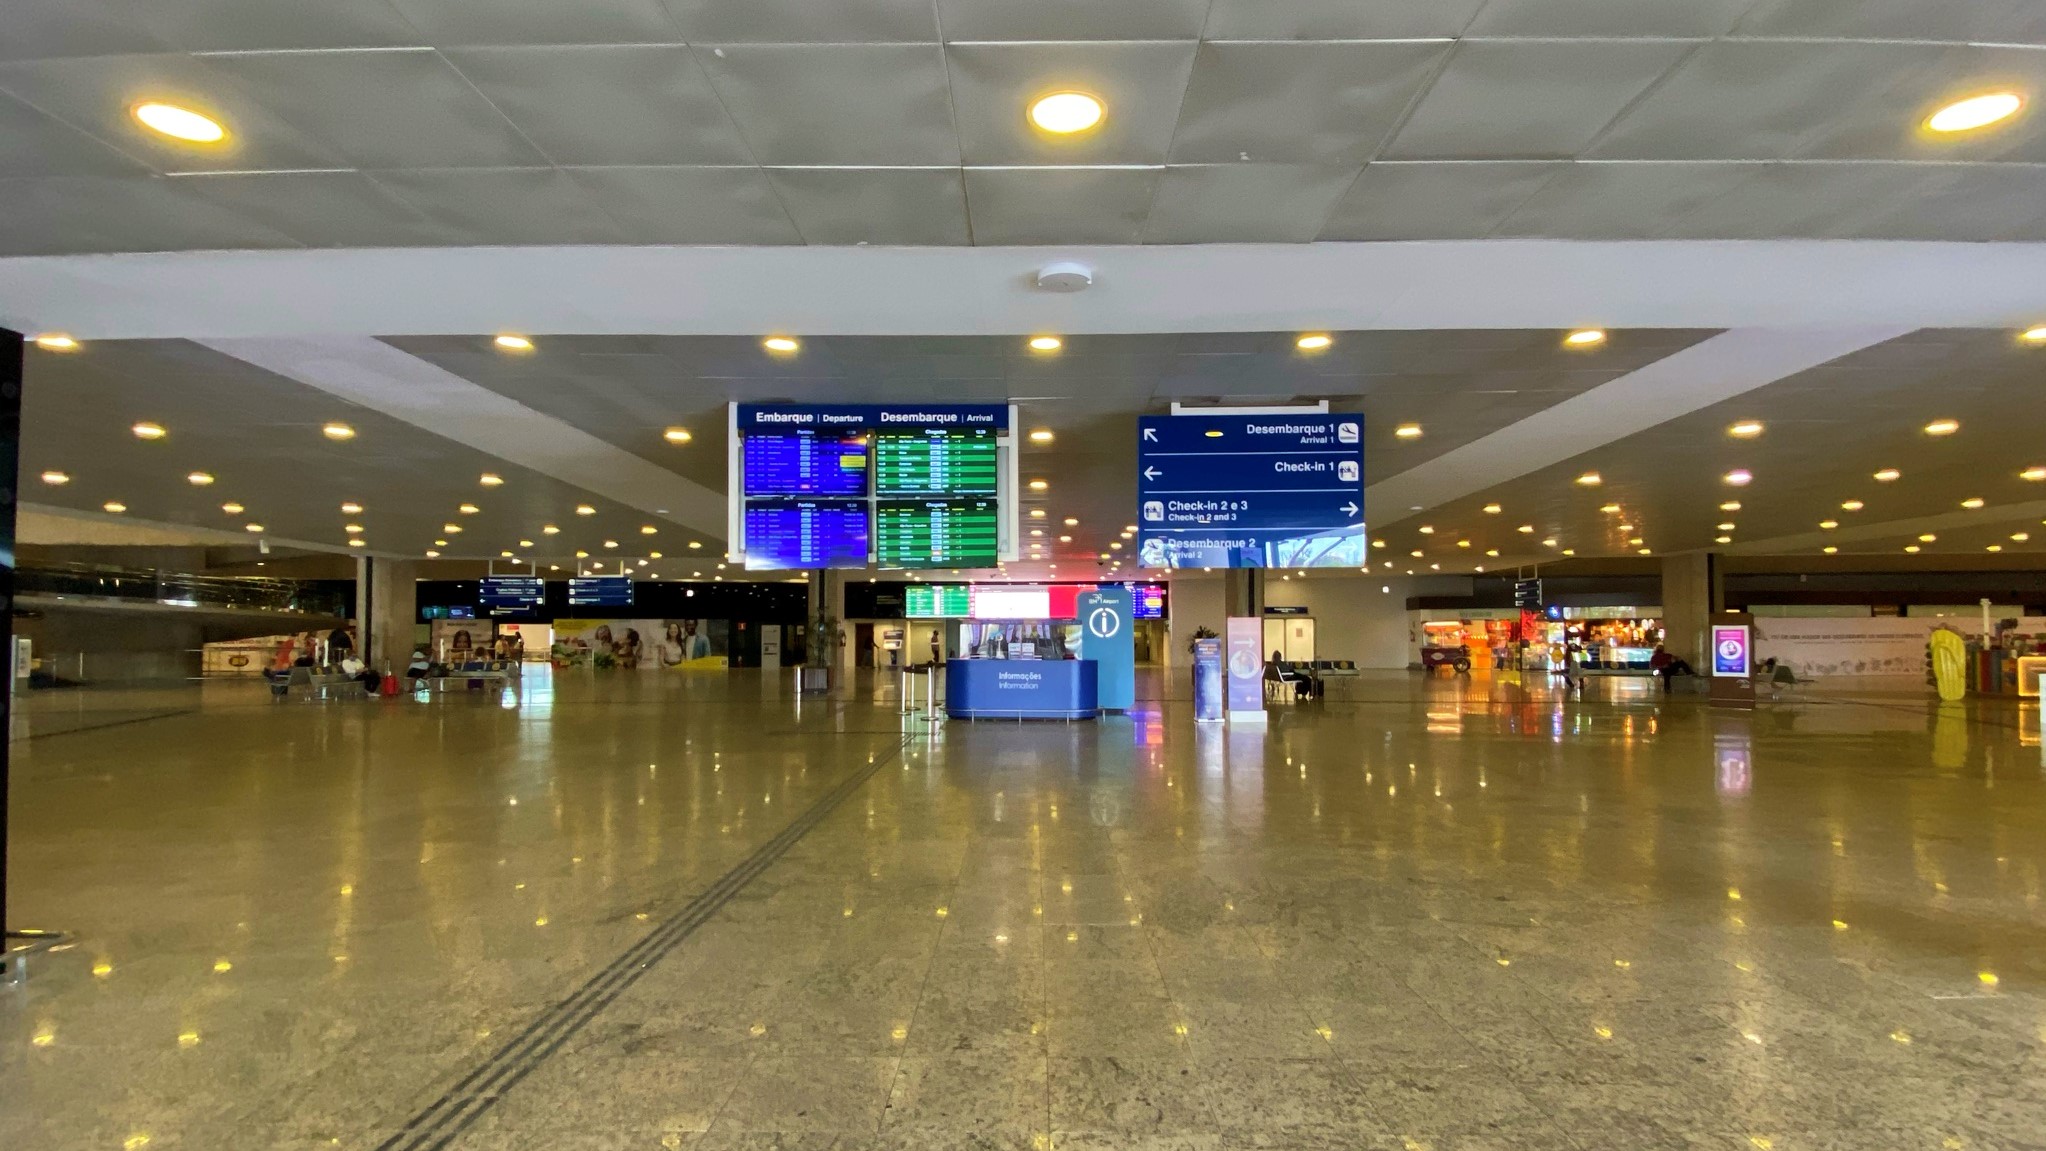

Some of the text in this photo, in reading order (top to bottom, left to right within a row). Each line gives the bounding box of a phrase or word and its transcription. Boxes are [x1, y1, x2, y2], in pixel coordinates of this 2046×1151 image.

[756, 412, 864, 424] Embarque Departure
[880, 412, 994, 424] Desembarque Arrival
[1246, 424, 1334, 435] Desembarque 1
[1300, 436, 1334, 444] Arrival 1
[1275, 461, 1334, 472] Check-in 1
[1168, 500, 1217, 511] Check-in
[1220, 500, 1228, 510] 2
[1241, 500, 1248, 510] 3
[1168, 513, 1237, 521] Check-in 2 and 3
[1168, 538, 1256, 550] Desembarque 2
[1168, 551, 1195, 559] Arrival
[998, 672, 1042, 681] Informações
[998, 681, 1039, 689] Information
